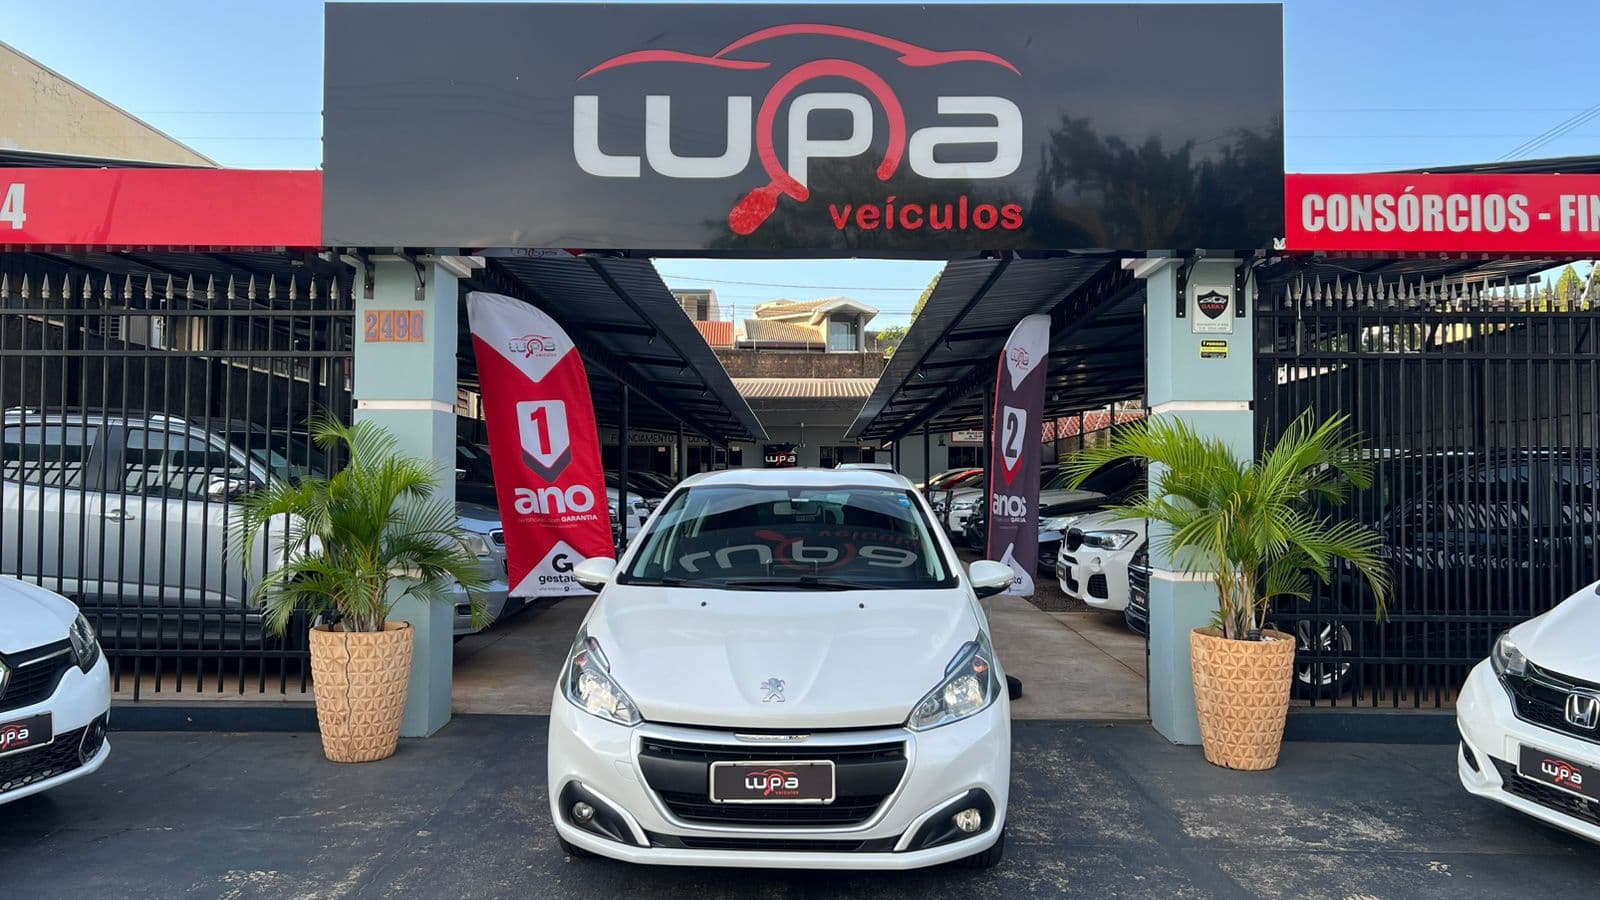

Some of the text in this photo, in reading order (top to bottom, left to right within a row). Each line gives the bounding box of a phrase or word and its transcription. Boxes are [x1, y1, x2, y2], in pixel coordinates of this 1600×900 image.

[829, 196, 1023, 231] veículos
[1301, 186, 1530, 232] CONSÓRCIOS
[366, 315, 424, 338] 2490
[530, 406, 552, 455] 1
[1005, 412, 1019, 459] 2
[514, 485, 595, 514] ano
[992, 492, 1027, 517] anos
[561, 514, 598, 522] GARANTIA
